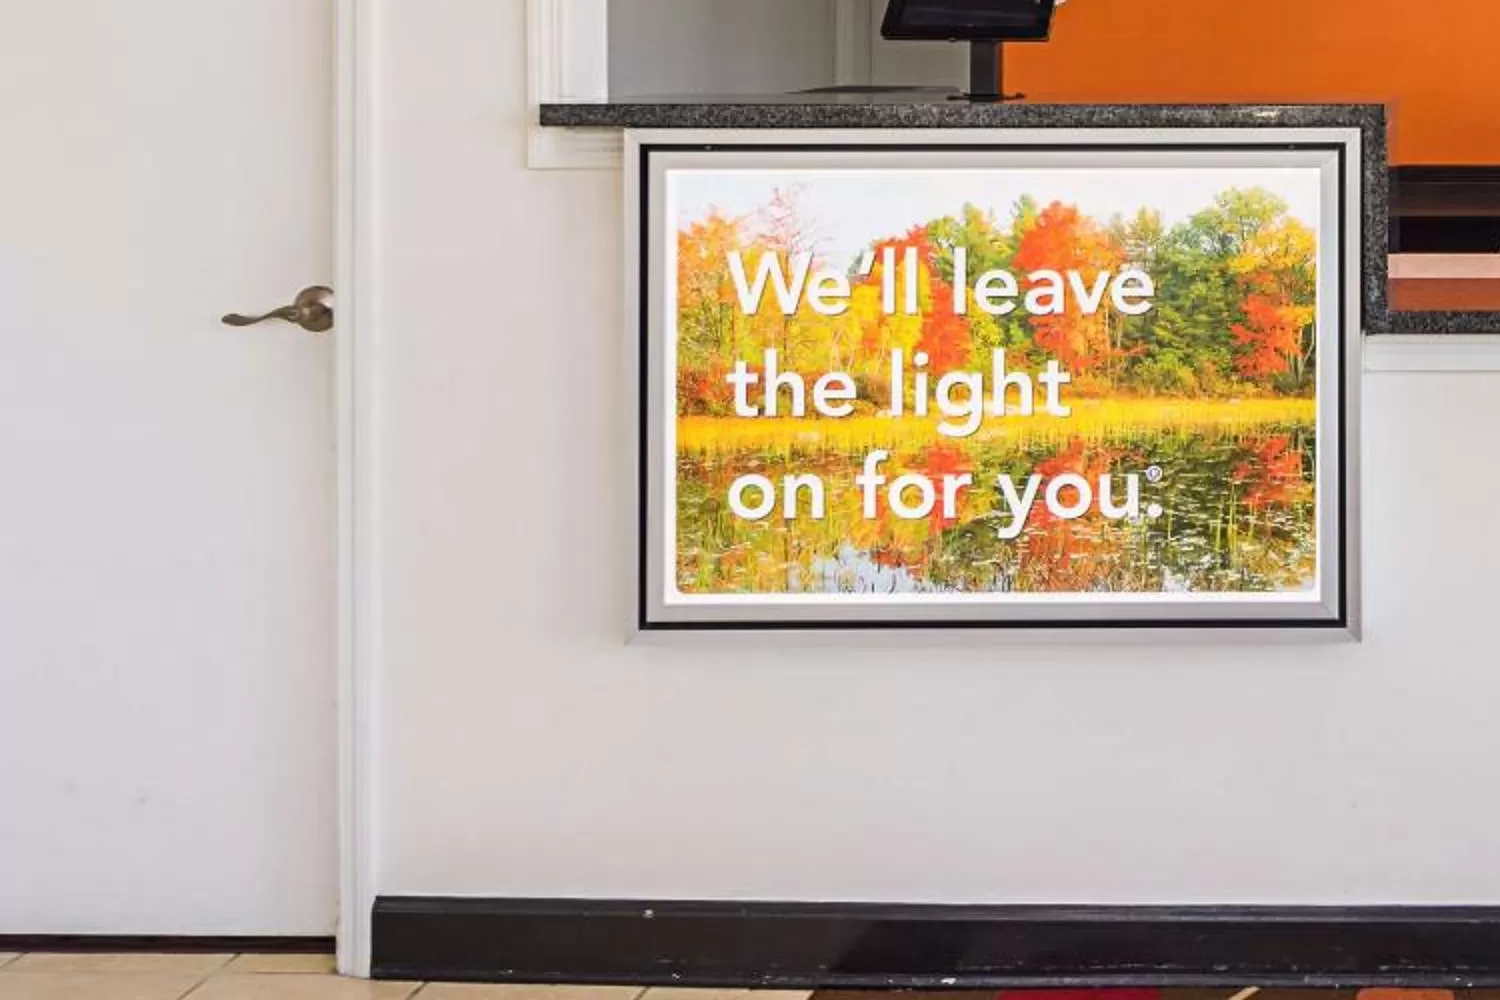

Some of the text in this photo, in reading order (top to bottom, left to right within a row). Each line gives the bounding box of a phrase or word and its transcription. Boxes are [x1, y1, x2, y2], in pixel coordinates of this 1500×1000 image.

[727, 247, 1155, 316] We'll leave
[727, 347, 1071, 437] the light
[727, 470, 824, 520] on
[856, 450, 972, 520] for
